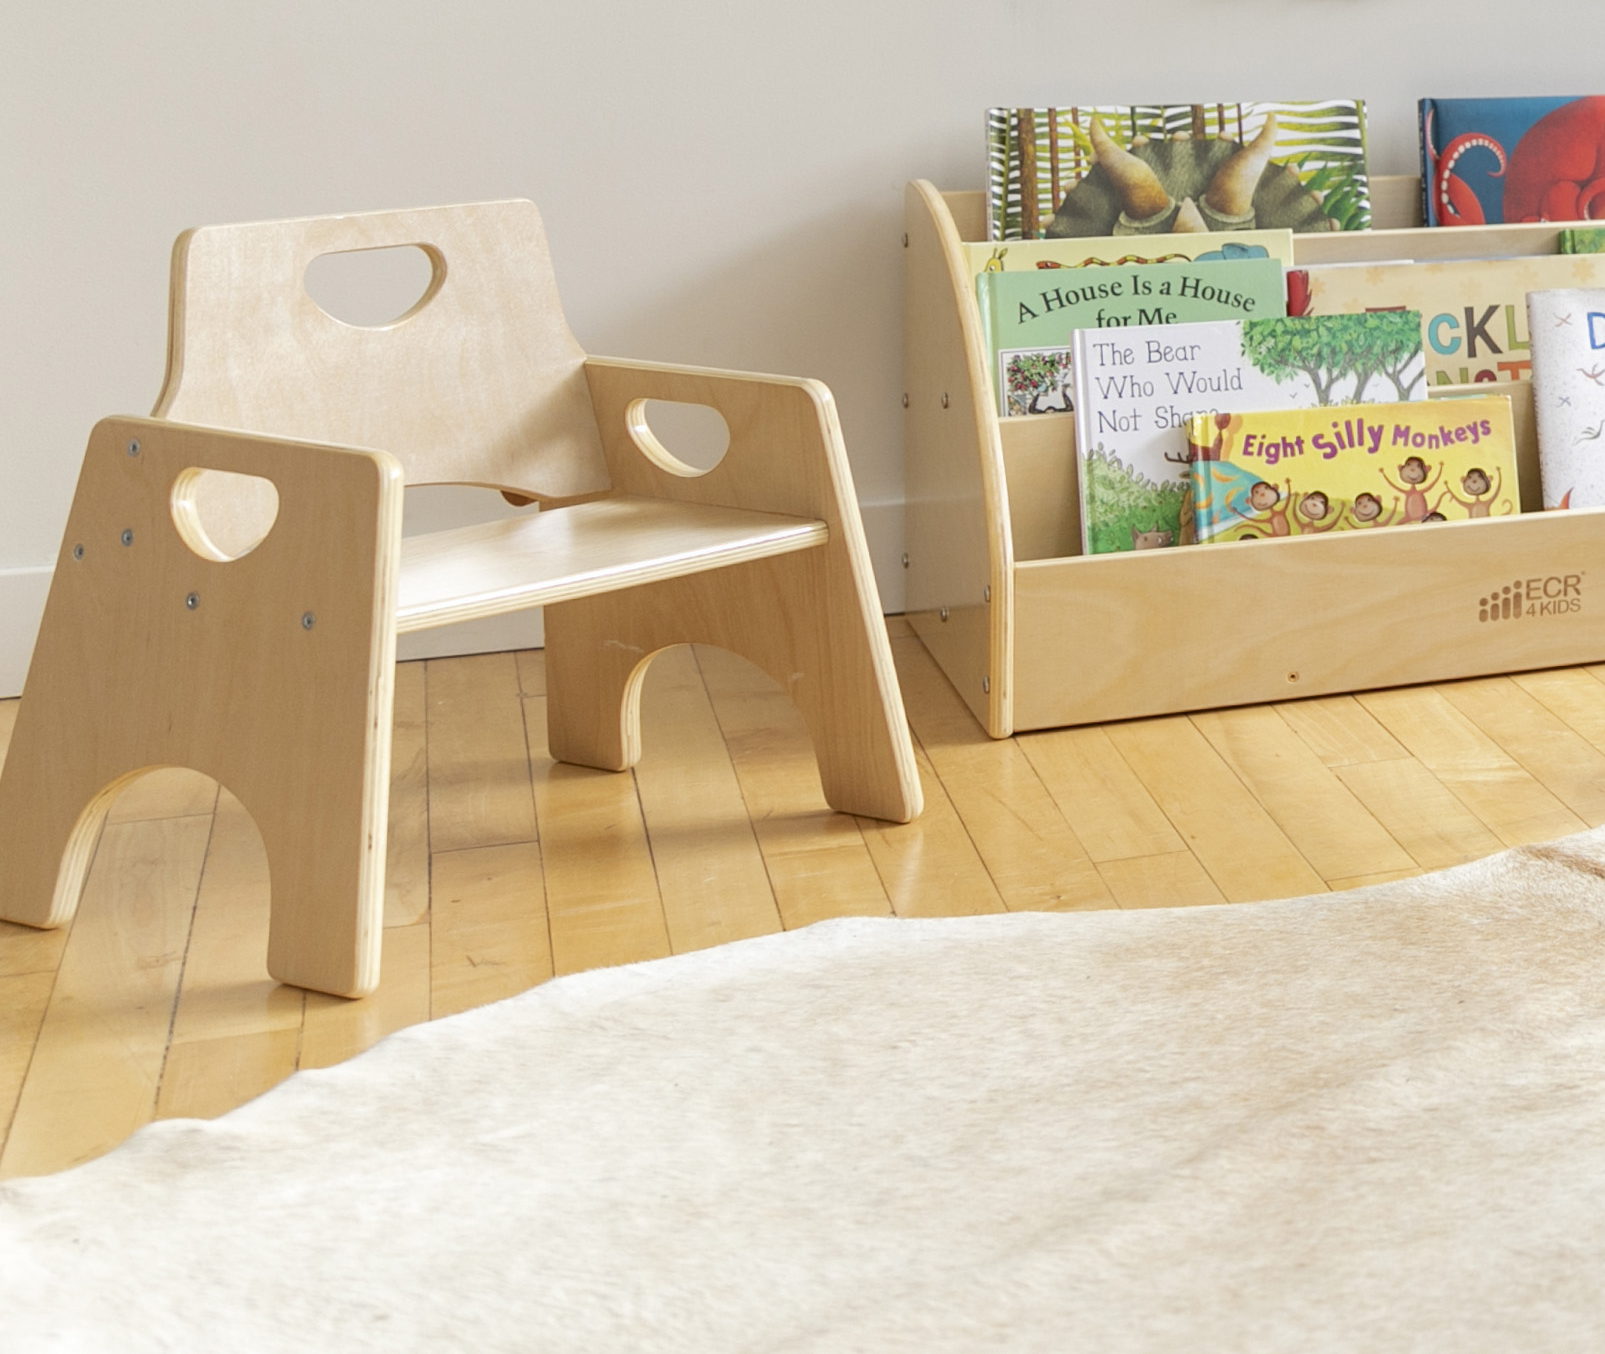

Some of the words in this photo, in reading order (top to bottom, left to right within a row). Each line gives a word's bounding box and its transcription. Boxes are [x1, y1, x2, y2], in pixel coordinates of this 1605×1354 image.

[1017, 301, 1039, 324] A
[1039, 281, 1123, 313] House
[1131, 275, 1152, 296] Is
[1158, 281, 1171, 296] a
[1180, 276, 1256, 313] House
[1096, 308, 1131, 328] for
[1138, 307, 1177, 326] Me
[1092, 342, 1135, 367] The
[1145, 339, 1202, 364] Bear
[1095, 374, 1155, 400] Who
[1164, 367, 1244, 395] Would
[1097, 407, 1143, 434] Not
[1242, 433, 1305, 465] Eight
[1311, 418, 1385, 460] Silly
[1391, 419, 1492, 450] Monkeys
[1525, 574, 1581, 601] ECR
